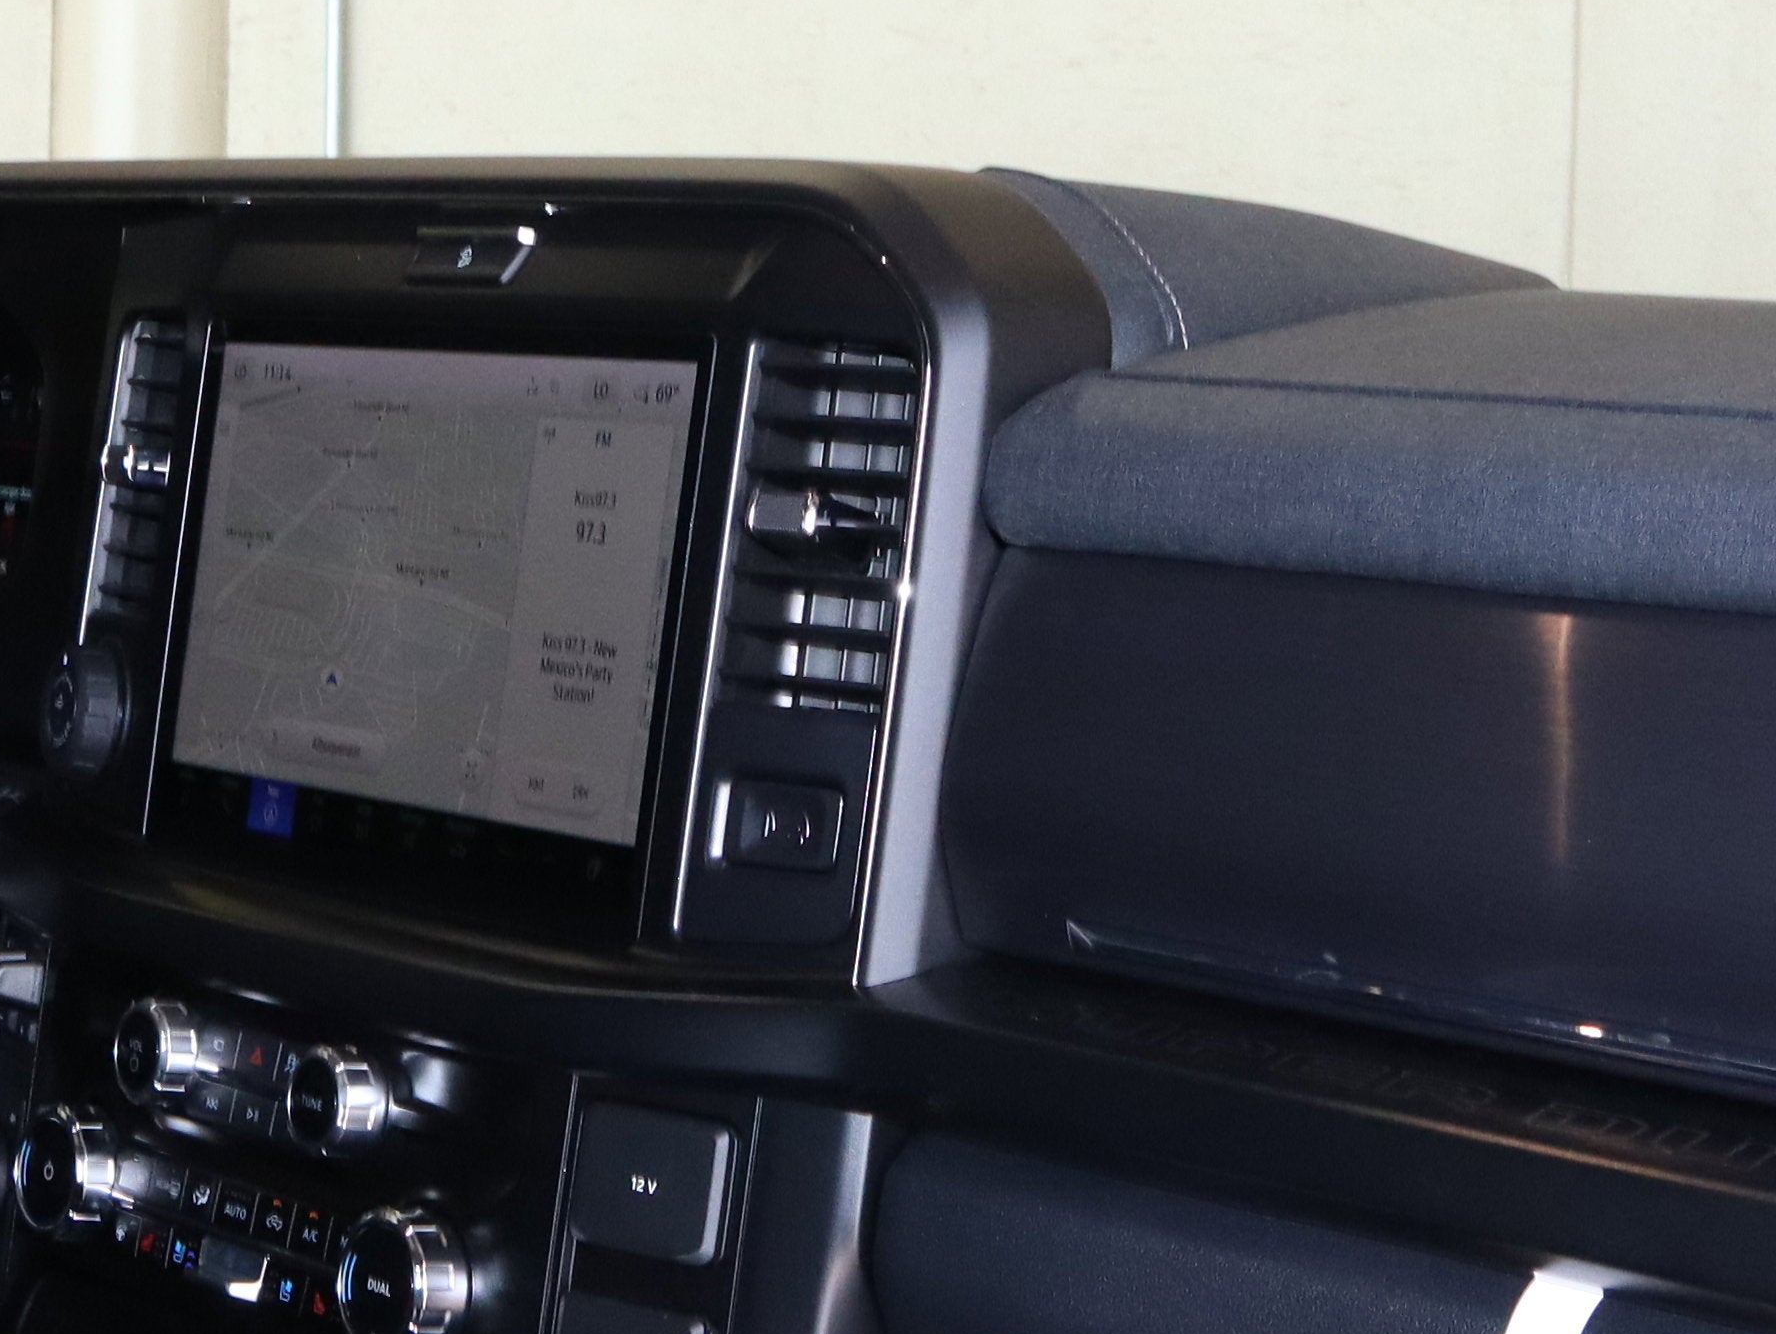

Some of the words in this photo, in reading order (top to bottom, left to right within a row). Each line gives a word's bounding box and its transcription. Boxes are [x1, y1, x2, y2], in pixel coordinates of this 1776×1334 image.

[575, 520, 606, 545] 97.3
[631, 1174, 646, 1193] 12
[647, 1181, 658, 1195] V
[224, 1203, 247, 1221] AUTO
[302, 1227, 319, 1244] A/C
[367, 1277, 391, 1299] DUAL
